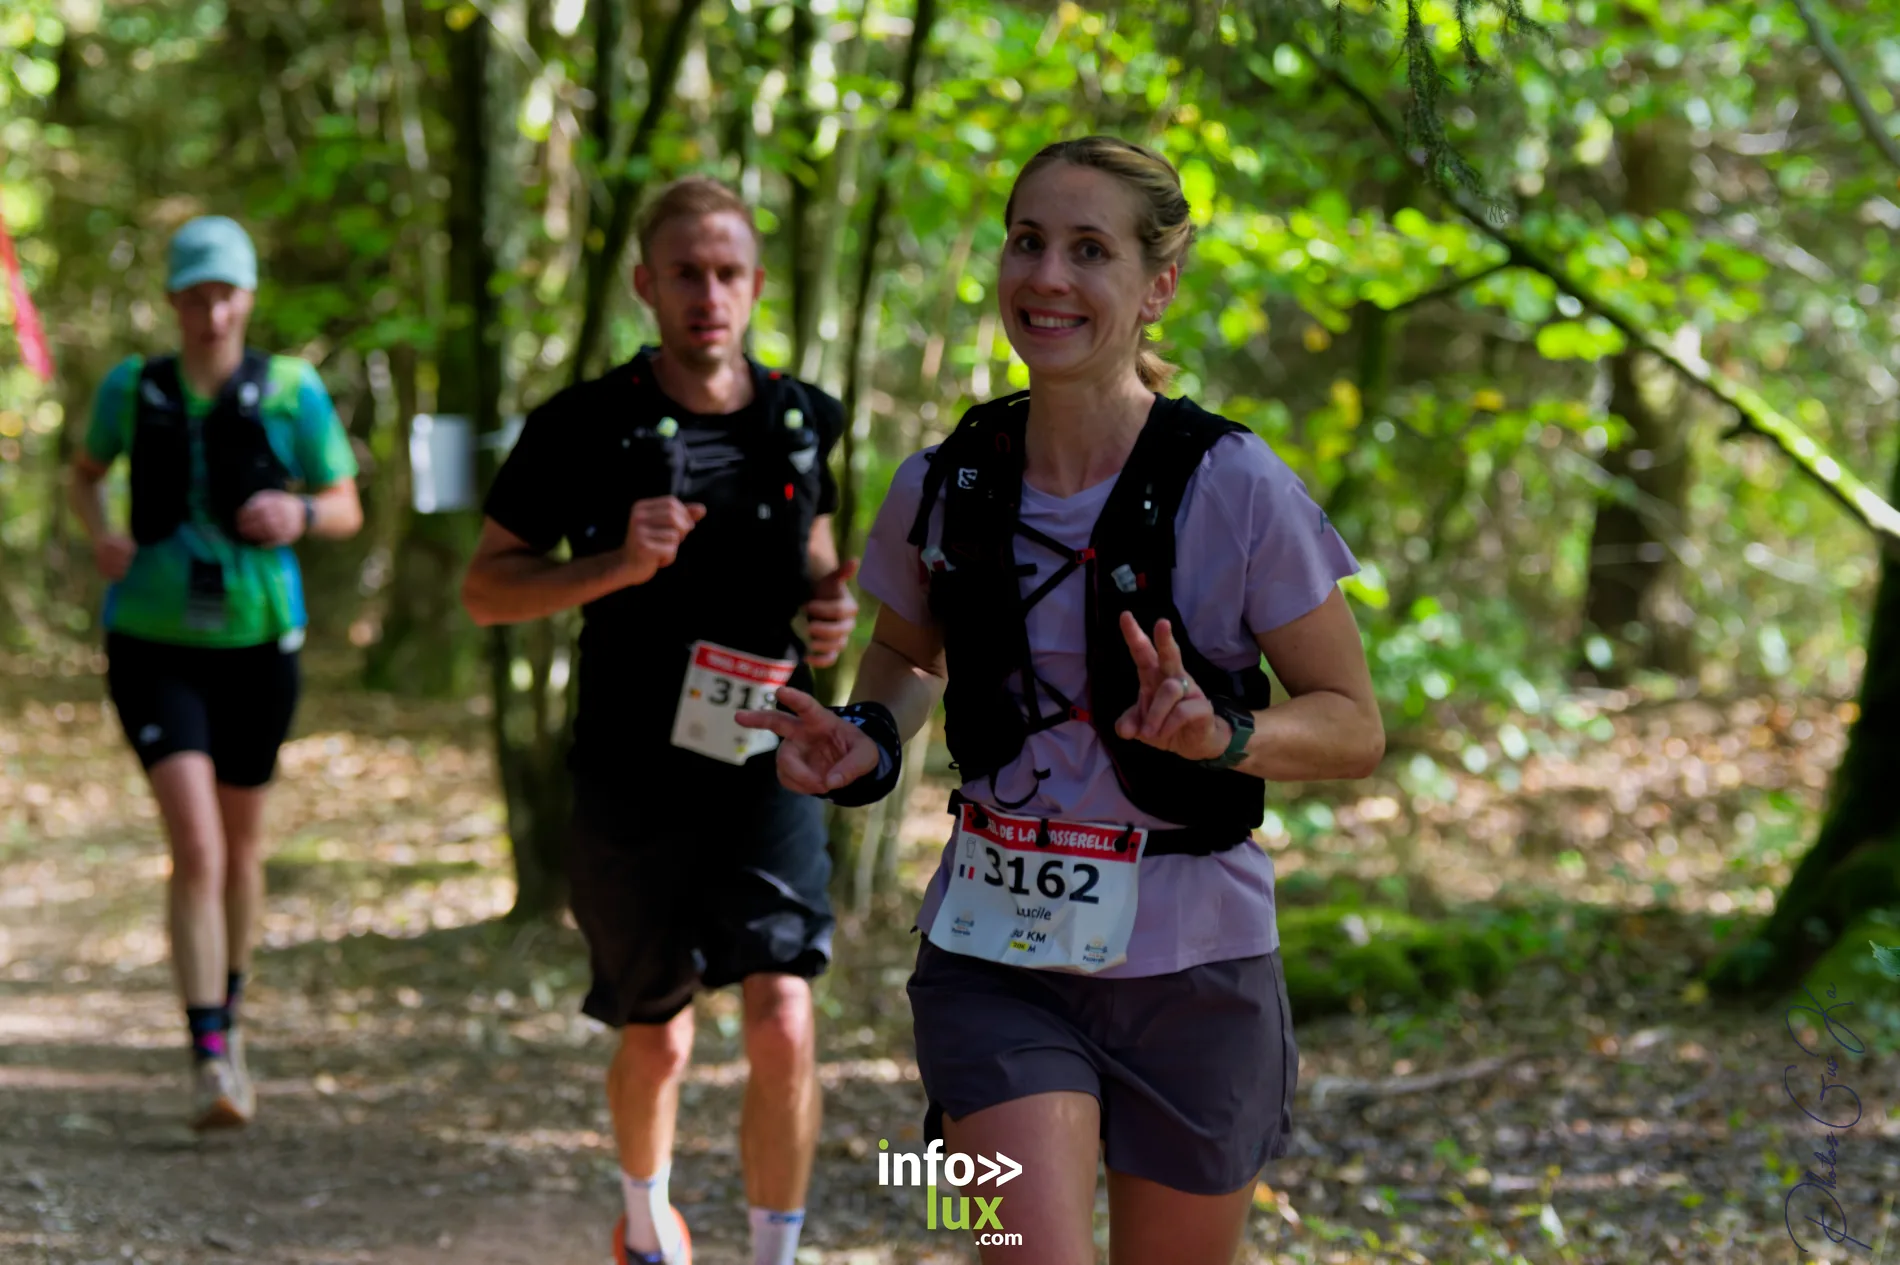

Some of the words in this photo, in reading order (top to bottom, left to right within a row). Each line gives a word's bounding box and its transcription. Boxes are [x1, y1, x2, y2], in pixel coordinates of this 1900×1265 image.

[708, 676, 778, 710] 318
[1000, 825, 1014, 841] DE
[1018, 827, 1036, 843] LA
[1048, 829, 1117, 852] ASSERELL
[984, 846, 1101, 904] 3162
[1027, 931, 1047, 944] KM
